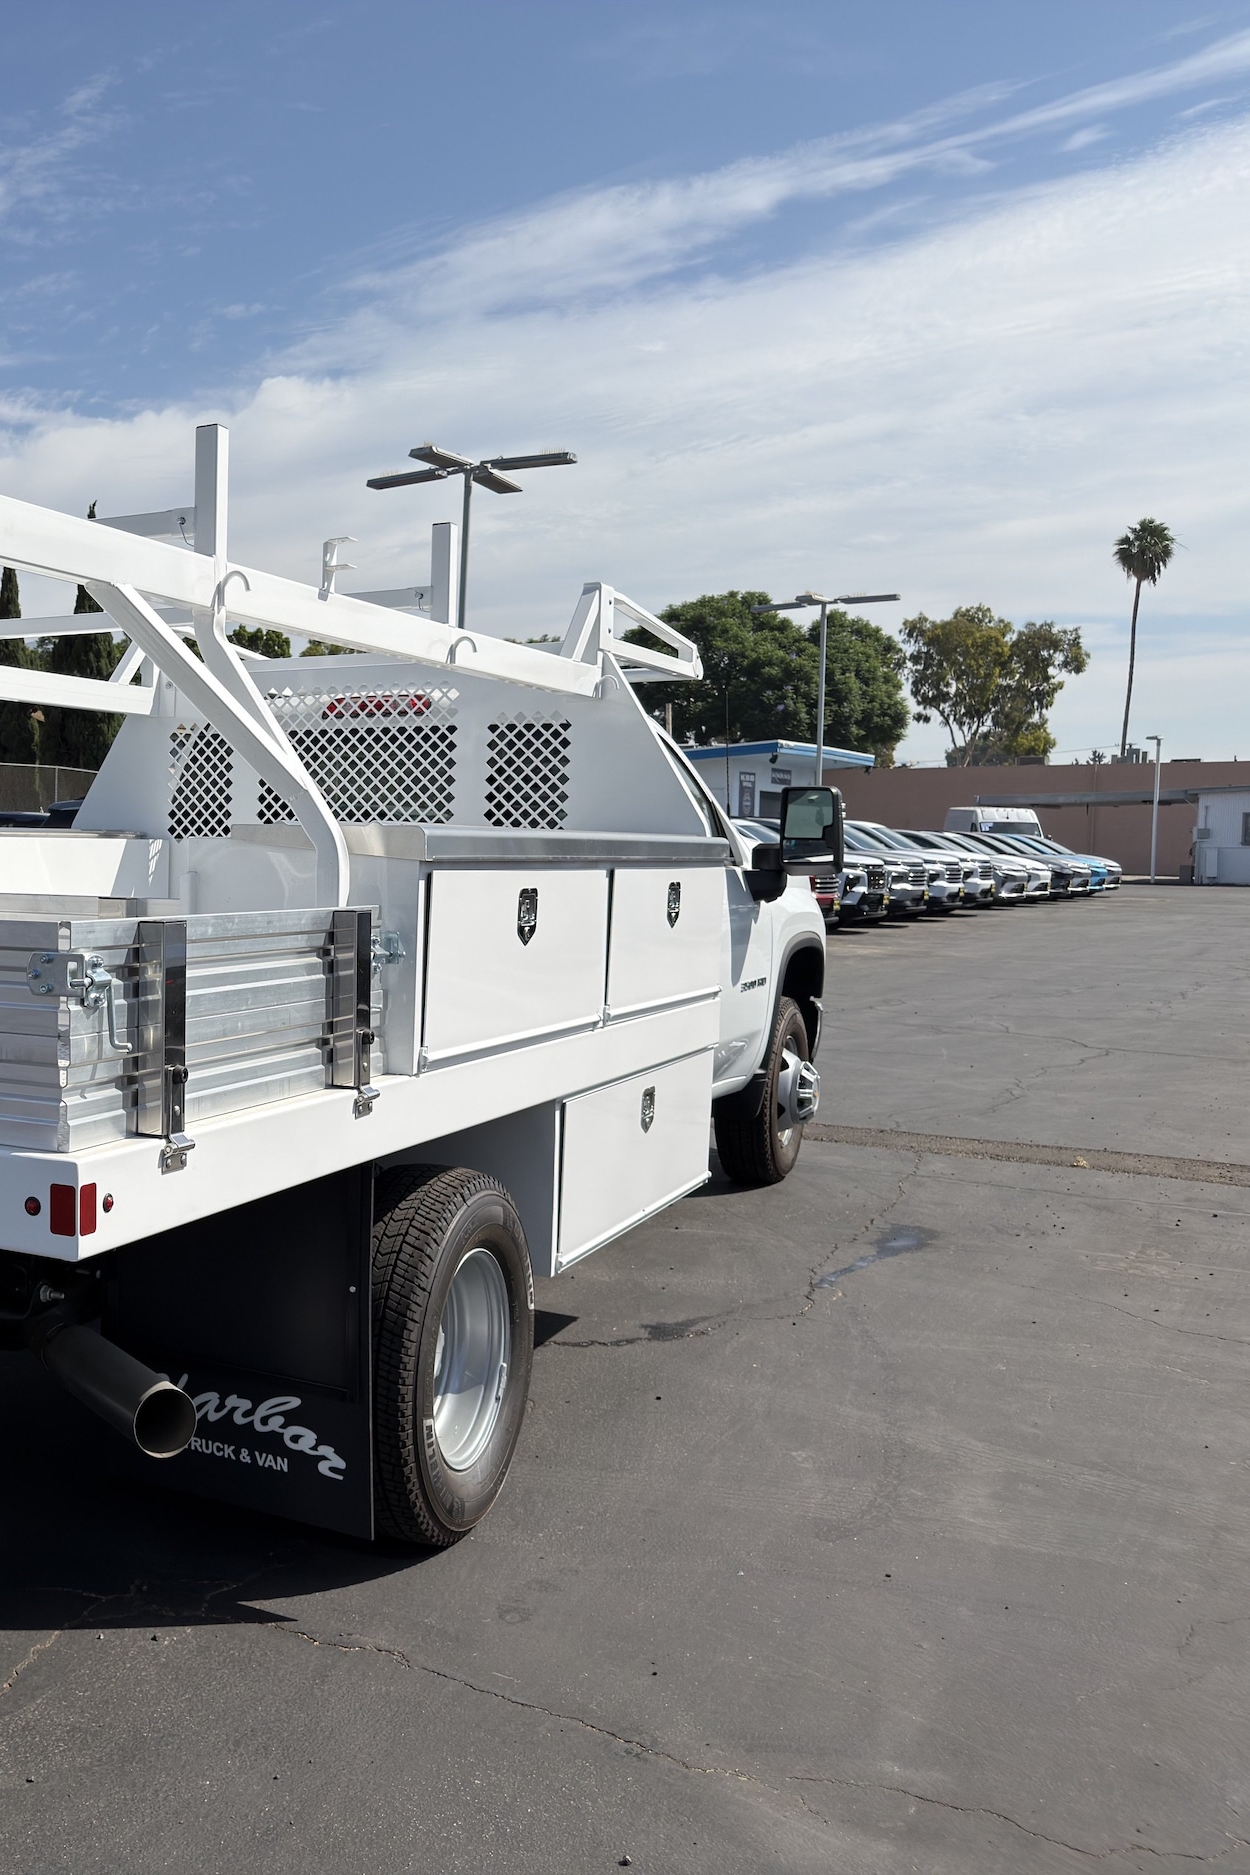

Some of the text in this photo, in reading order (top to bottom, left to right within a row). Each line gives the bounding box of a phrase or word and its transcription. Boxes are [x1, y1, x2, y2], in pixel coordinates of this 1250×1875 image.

[157, 1373, 347, 1481] arbor
[187, 1437, 289, 1473] RUCK & VAN
